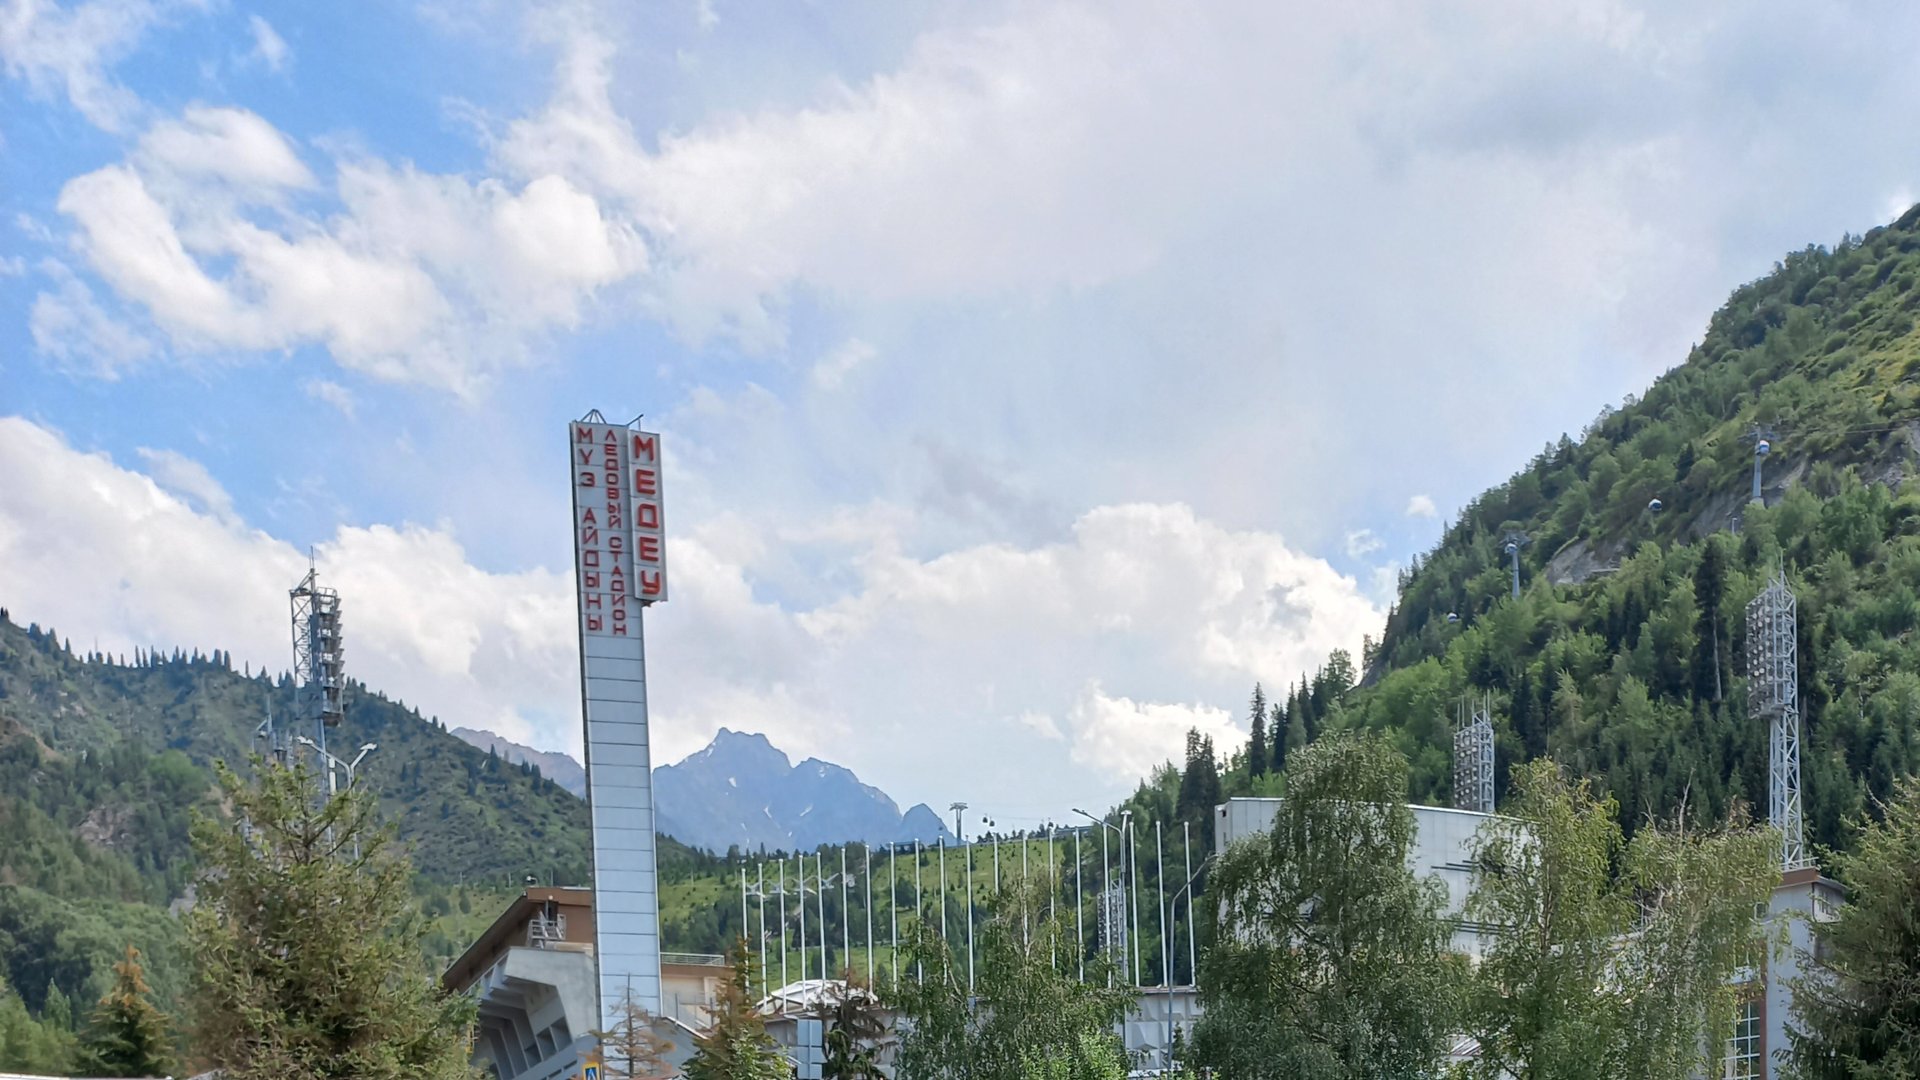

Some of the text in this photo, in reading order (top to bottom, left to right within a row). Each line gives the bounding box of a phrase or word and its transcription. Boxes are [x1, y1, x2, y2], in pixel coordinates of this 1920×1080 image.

[582, 507, 602, 631] АЙДЫНЫ
[604, 429, 626, 635] ЛЕДОВЫЙ СТАДИОН
[633, 434, 661, 595] МЕДЕУ
